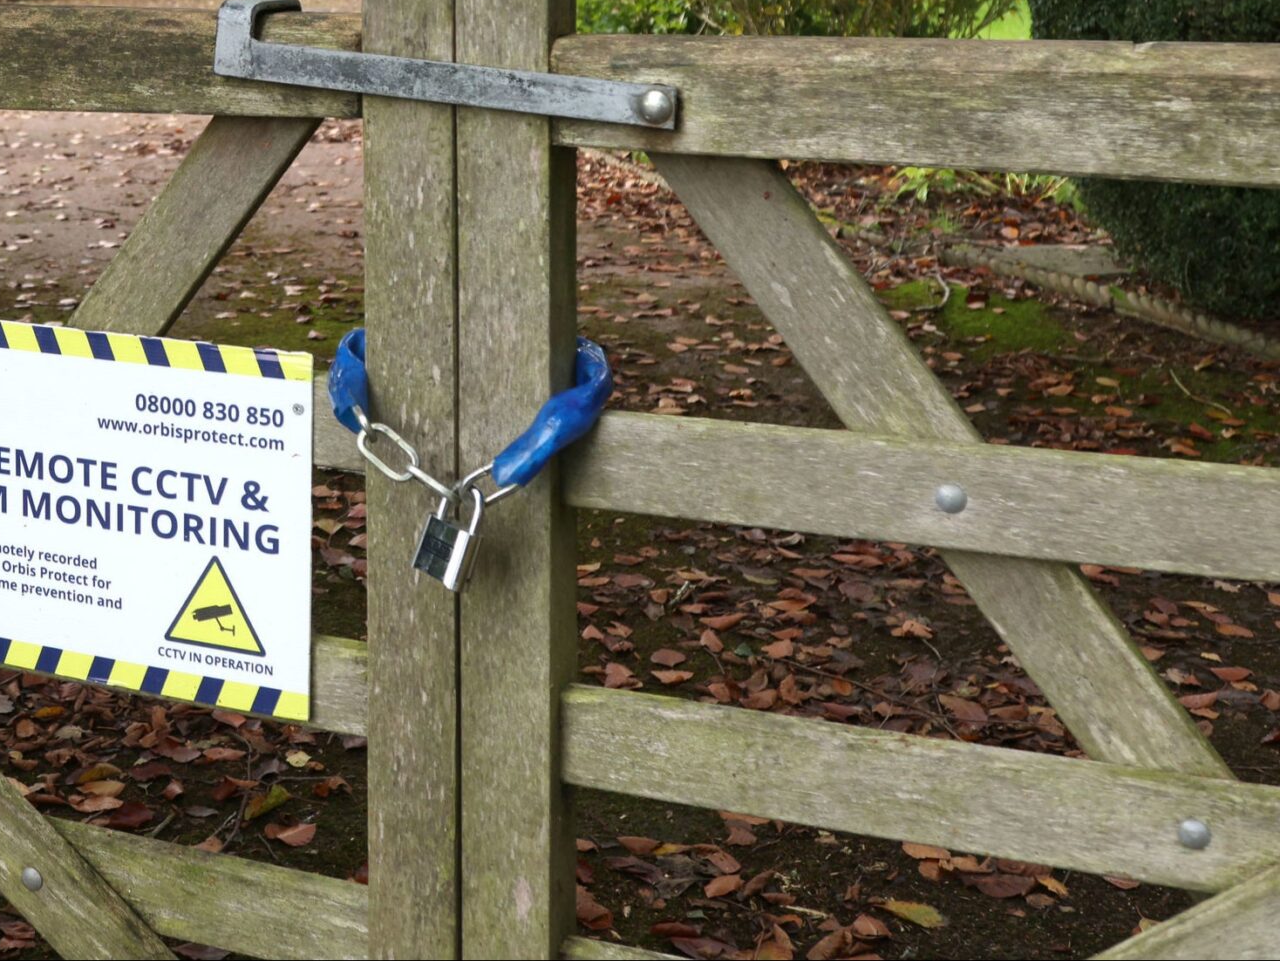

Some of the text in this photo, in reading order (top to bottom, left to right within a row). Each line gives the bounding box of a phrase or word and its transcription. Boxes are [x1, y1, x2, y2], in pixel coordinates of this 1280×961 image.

[135, 393, 284, 428] 08000 830 850
[97, 415, 284, 451] www.orbisprotect.com
[131, 466, 228, 505] CCTV
[241, 480, 269, 512] &
[22, 489, 279, 556] MONITORING
[2, 560, 36, 577] Orbis
[40, 567, 88, 586] Protect
[92, 575, 111, 589] for
[39, 552, 97, 569] recorded
[21, 581, 93, 605] prevention
[97, 597, 122, 609] and
[158, 647, 273, 676] CCTV IN OPERATION
